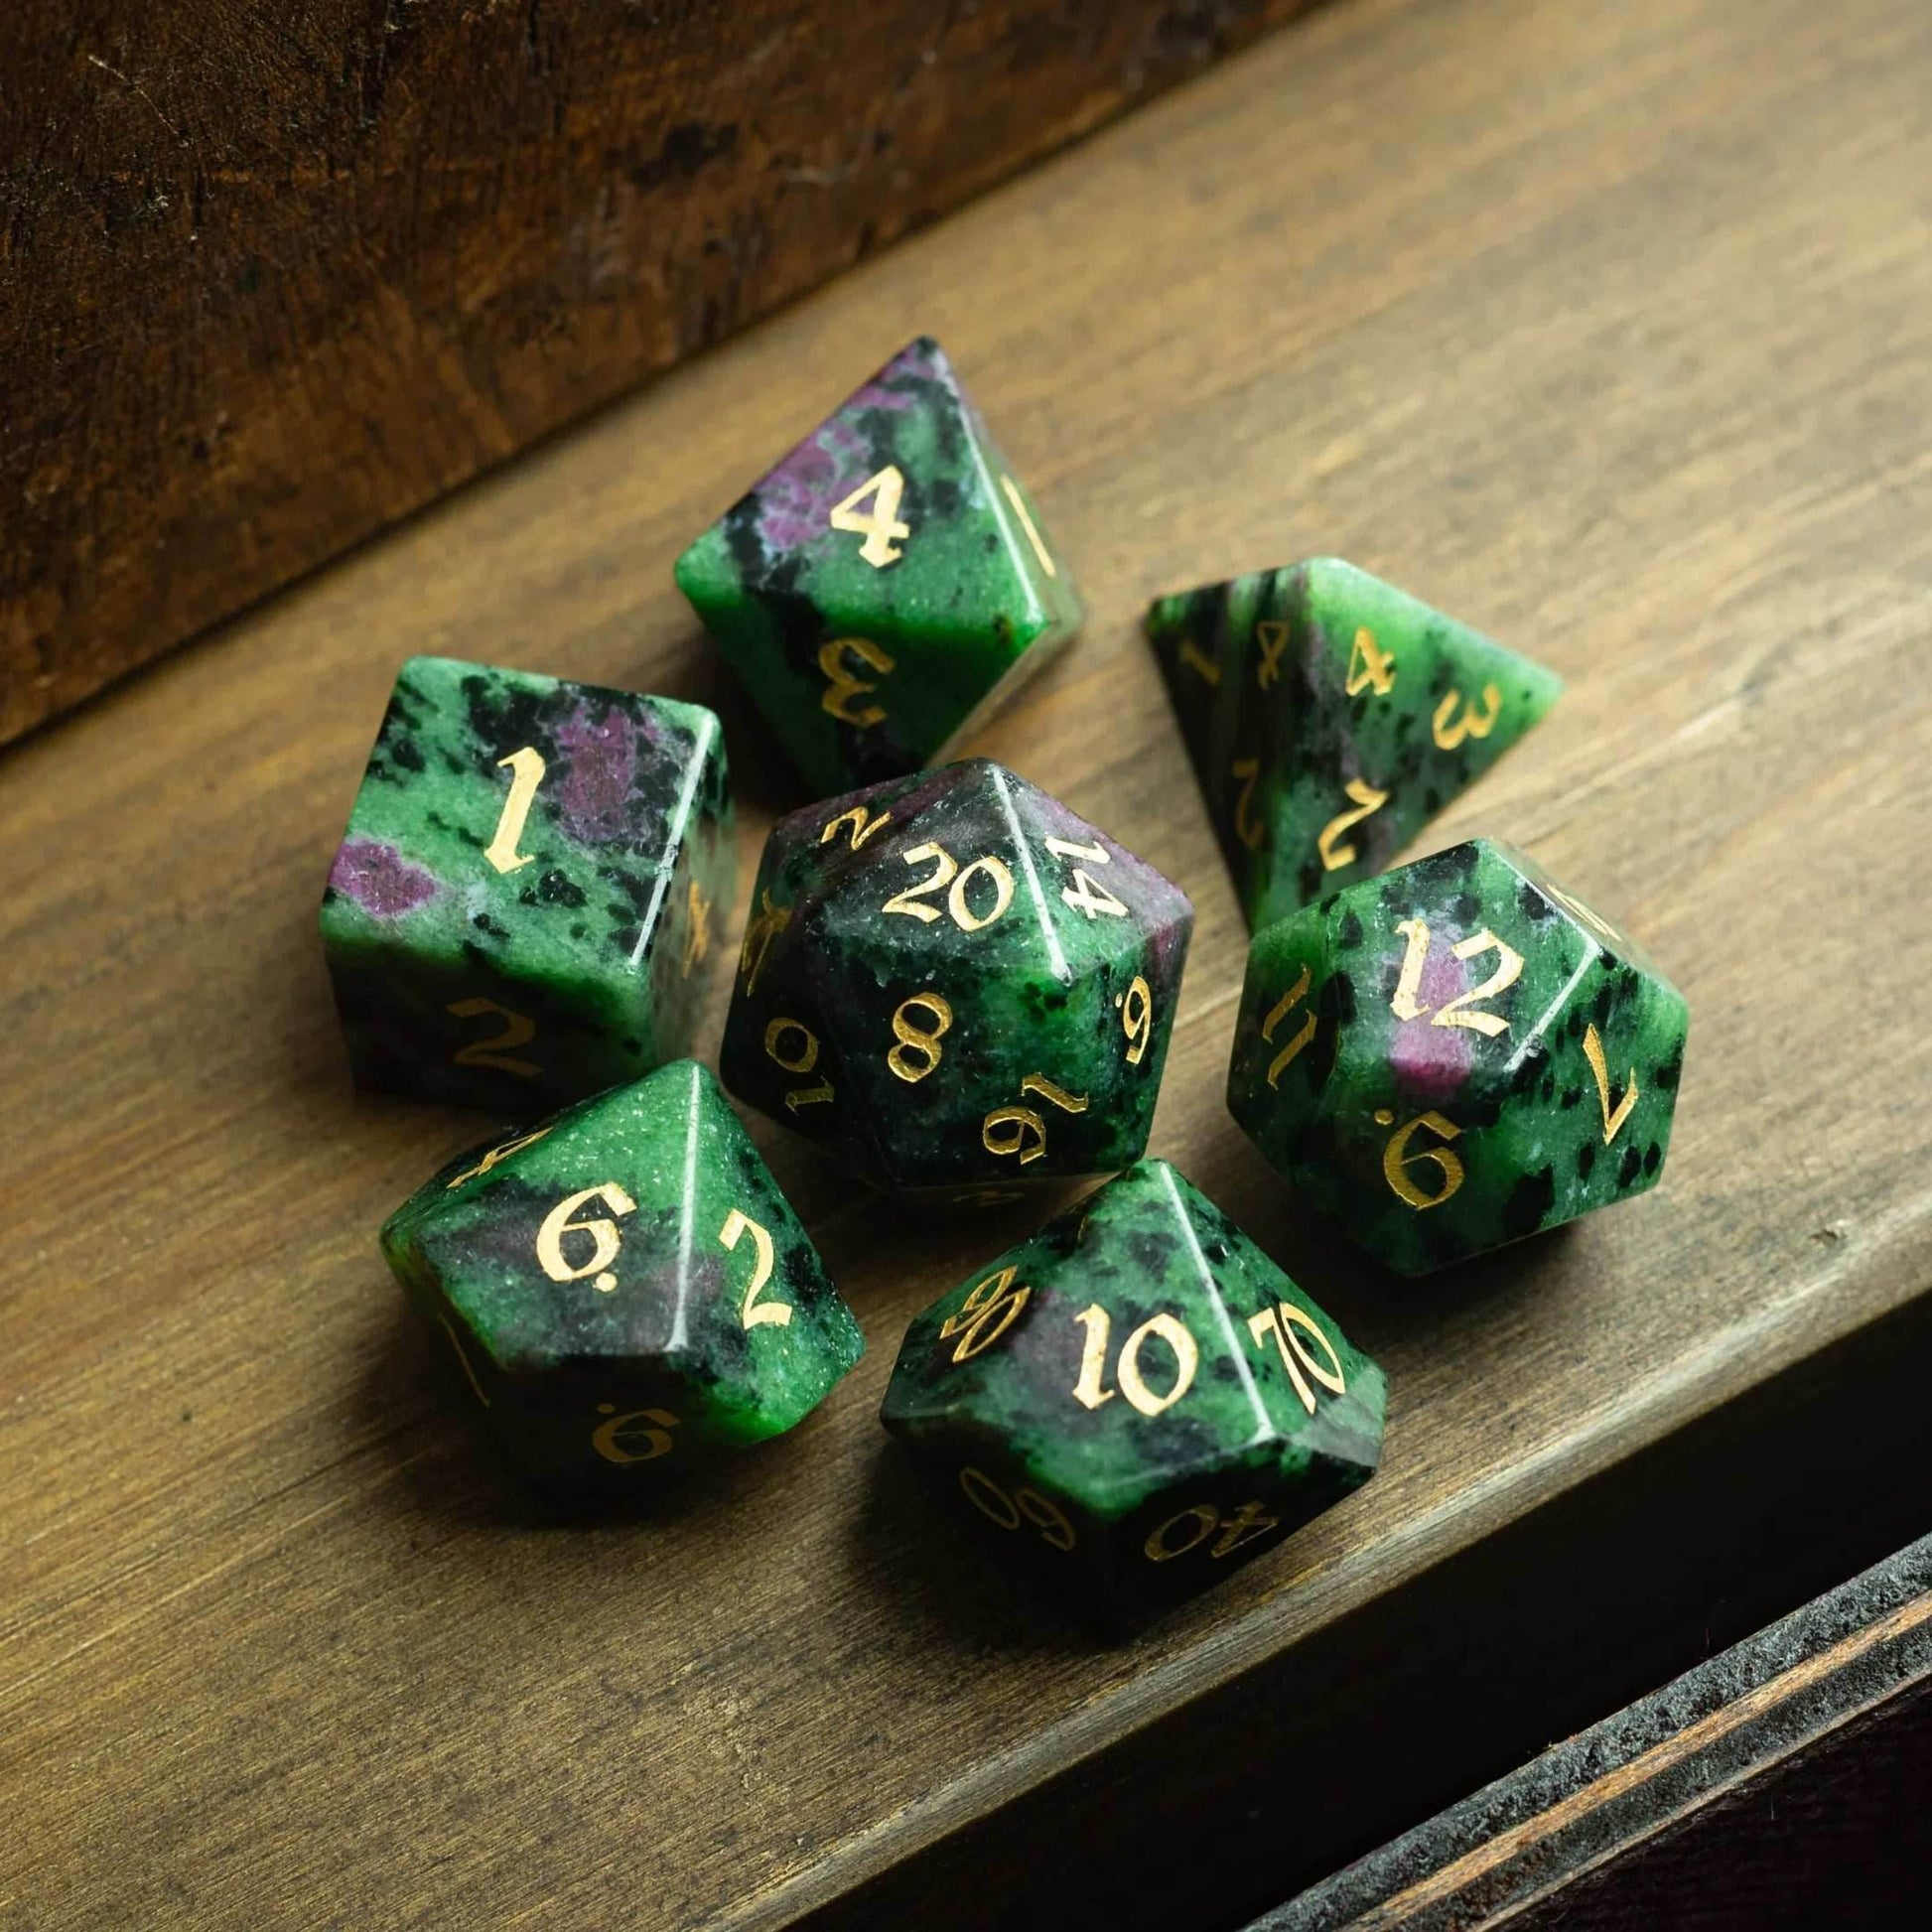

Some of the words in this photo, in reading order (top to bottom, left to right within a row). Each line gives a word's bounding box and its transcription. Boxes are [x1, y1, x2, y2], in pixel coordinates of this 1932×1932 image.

[830, 465, 909, 569] 4
[818, 636, 895, 727] 3
[1345, 626, 1397, 696] 4
[1433, 683, 1501, 751] 3
[483, 747, 545, 875] 1
[820, 806, 892, 851] 2
[1317, 777, 1388, 872] 2
[882, 841, 1015, 932] 20
[1044, 834, 1130, 919] 14
[1390, 918, 1525, 1037] 12
[446, 997, 544, 1078] 2
[765, 1017, 835, 1112] 10
[887, 993, 953, 1083] 8
[719, 1208, 792, 1330] 2
[1072, 1303, 1199, 1417] 10
[1247, 1302, 1346, 1415] 70
[1144, 1500, 1279, 1562] 40
